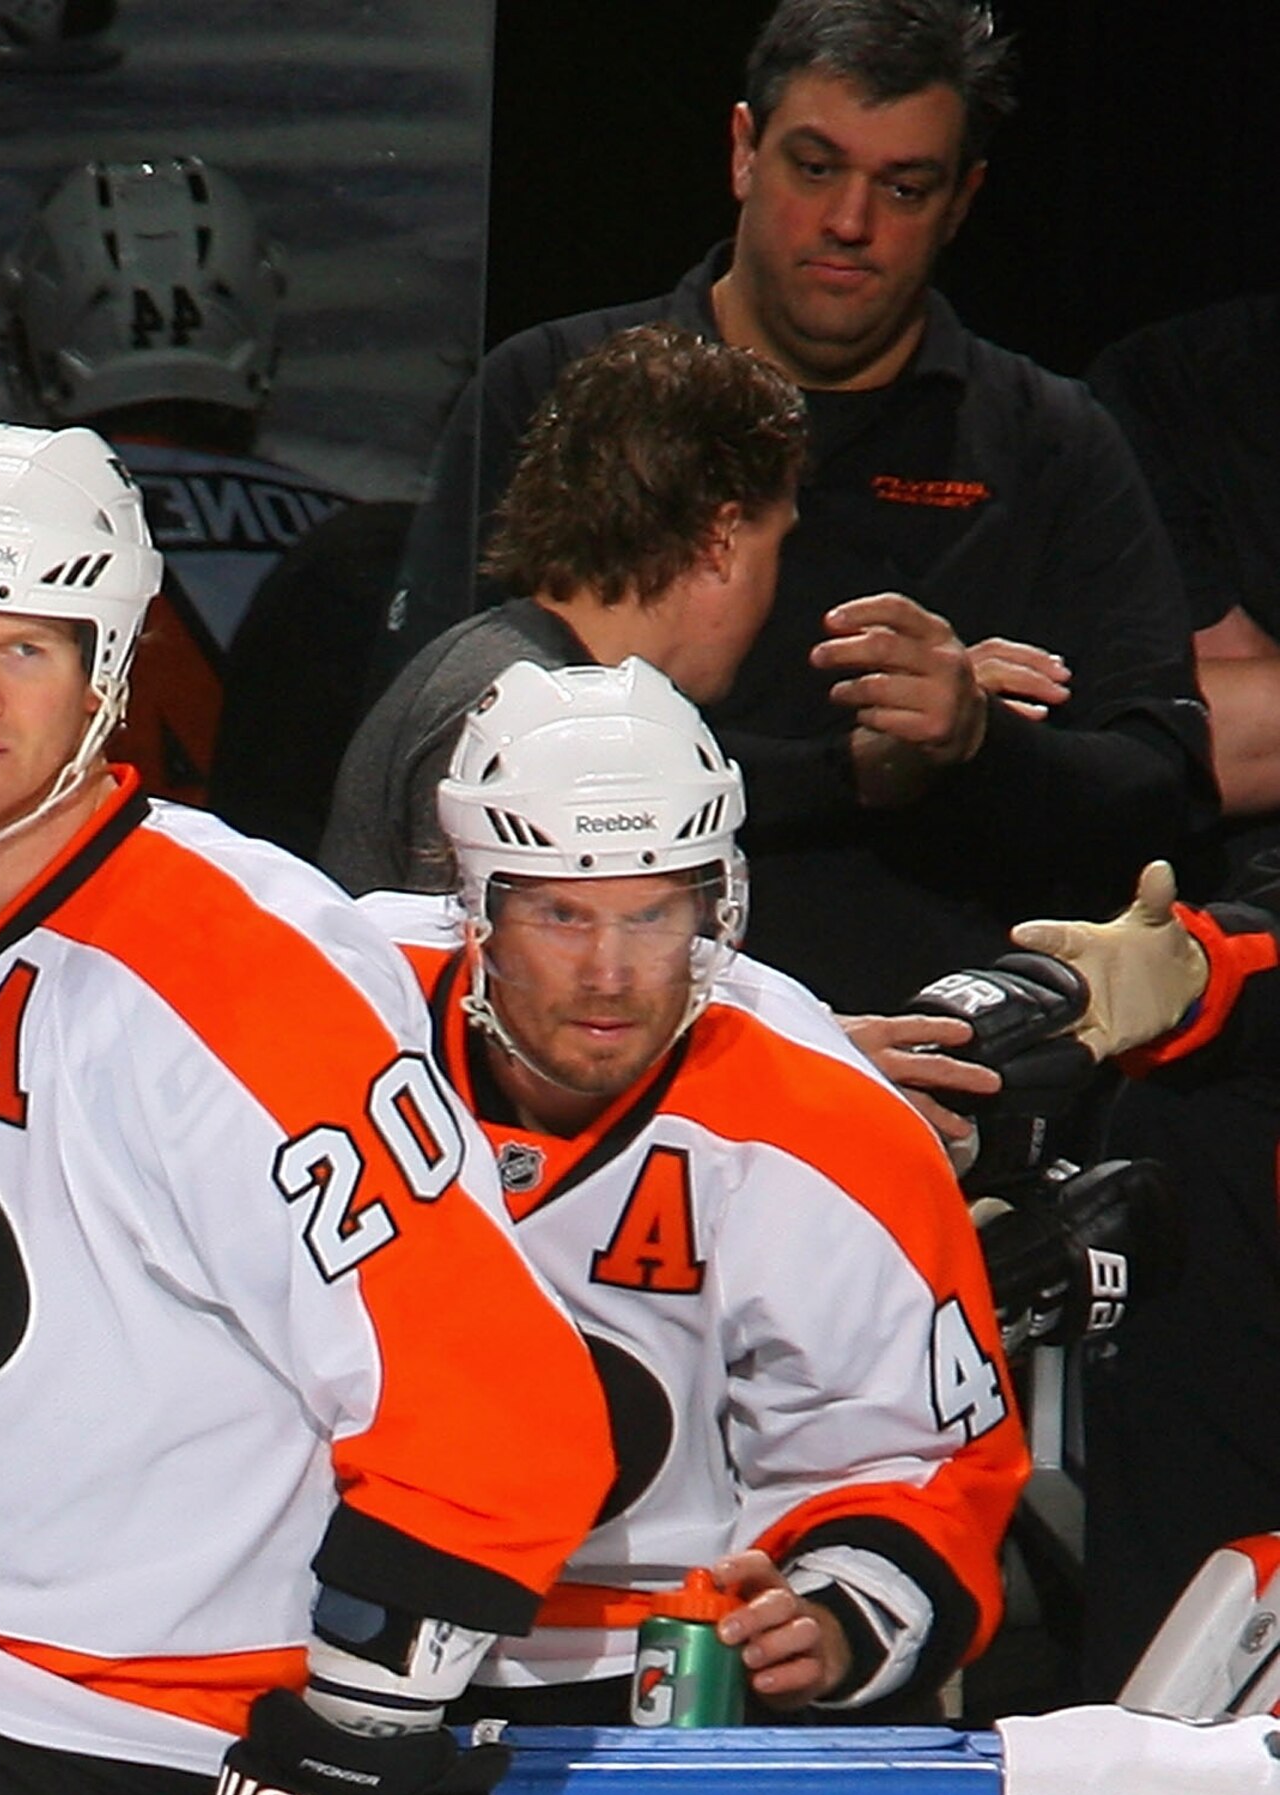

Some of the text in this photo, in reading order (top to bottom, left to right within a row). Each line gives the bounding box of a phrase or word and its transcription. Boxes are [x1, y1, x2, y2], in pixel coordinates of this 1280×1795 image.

[576, 811, 658, 834] Reebok
[271, 1048, 466, 1284] 20
[589, 1144, 707, 1294] A
[928, 1294, 1009, 1446] 4
[631, 1648, 677, 1728] G
